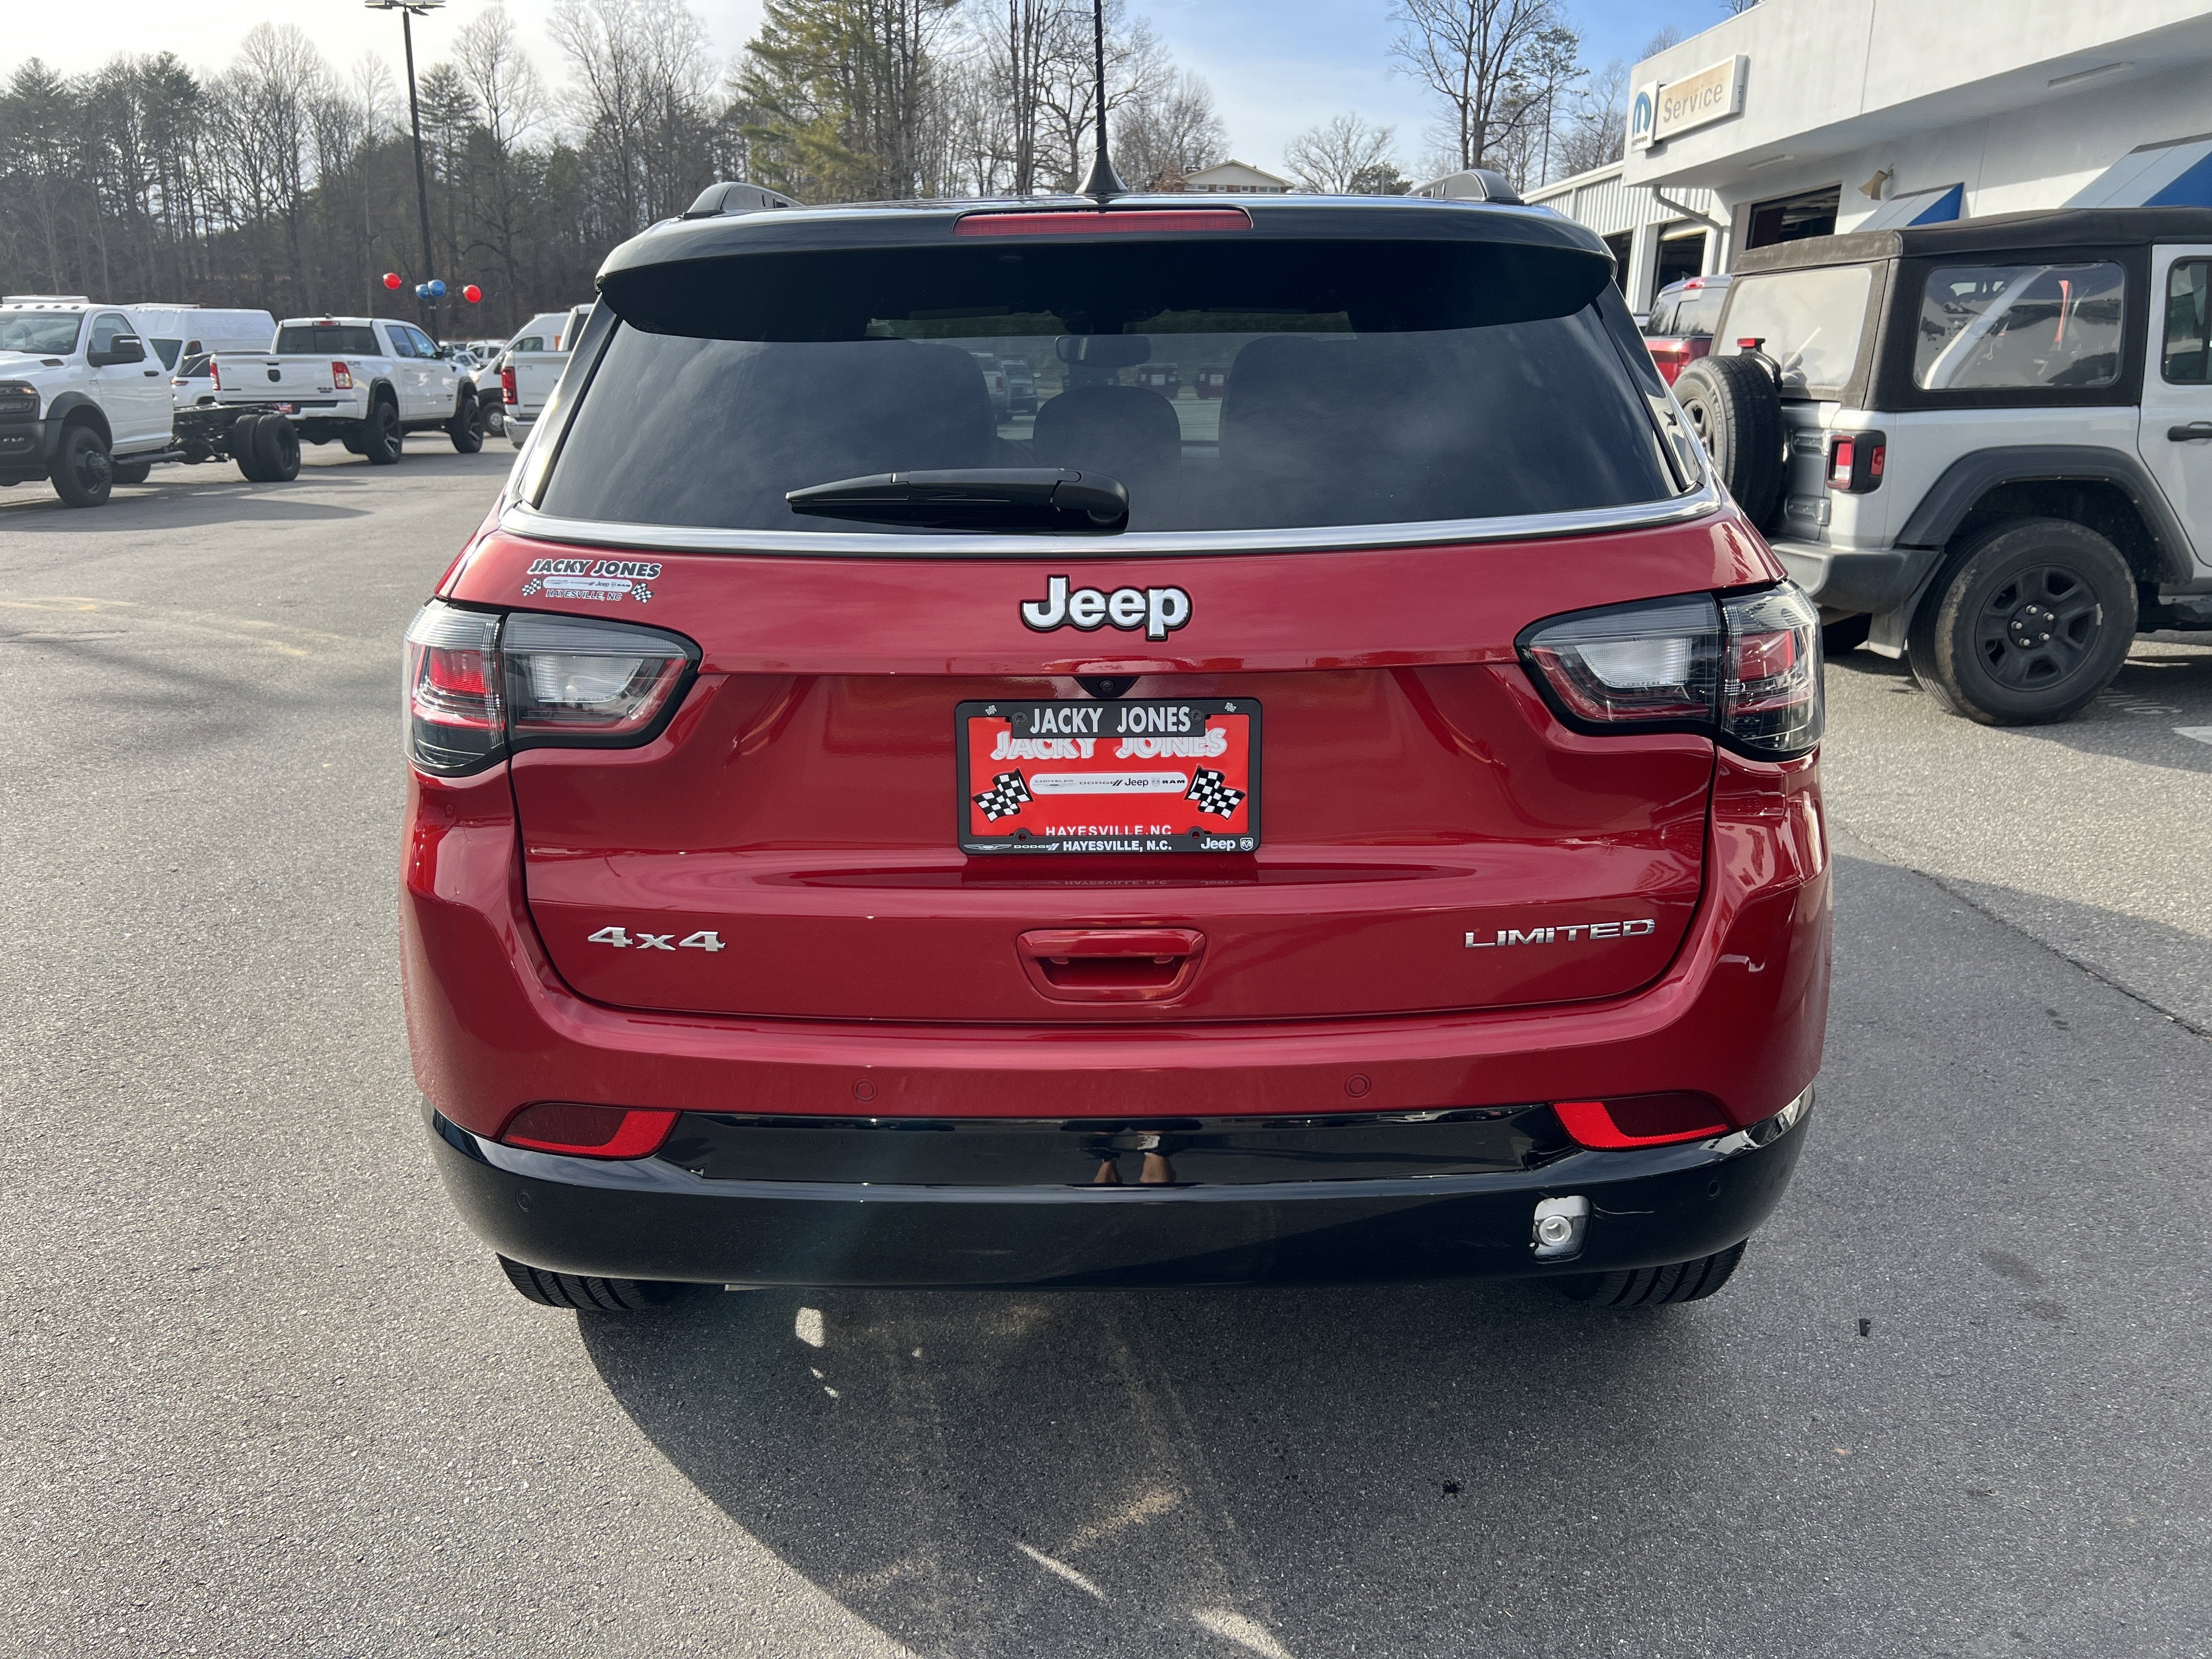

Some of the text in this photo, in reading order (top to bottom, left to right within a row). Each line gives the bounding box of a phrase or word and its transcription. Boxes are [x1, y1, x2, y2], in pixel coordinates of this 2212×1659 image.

[1663, 83, 1723, 123] Service
[527, 558, 662, 580] JACKY JONES
[546, 590, 623, 601] HAYESVILLE, NC
[1022, 576, 1190, 639] Jeep
[1030, 706, 1191, 735] JACKY JONES
[990, 727, 1227, 760] JACKY JONES
[1125, 778, 1149, 787] Jeep
[1063, 840, 1143, 852] HAYESVILLE,
[1147, 840, 1172, 850] N.C.
[1200, 837, 1236, 851] Jeep
[1464, 919, 1655, 948] LIMITED
